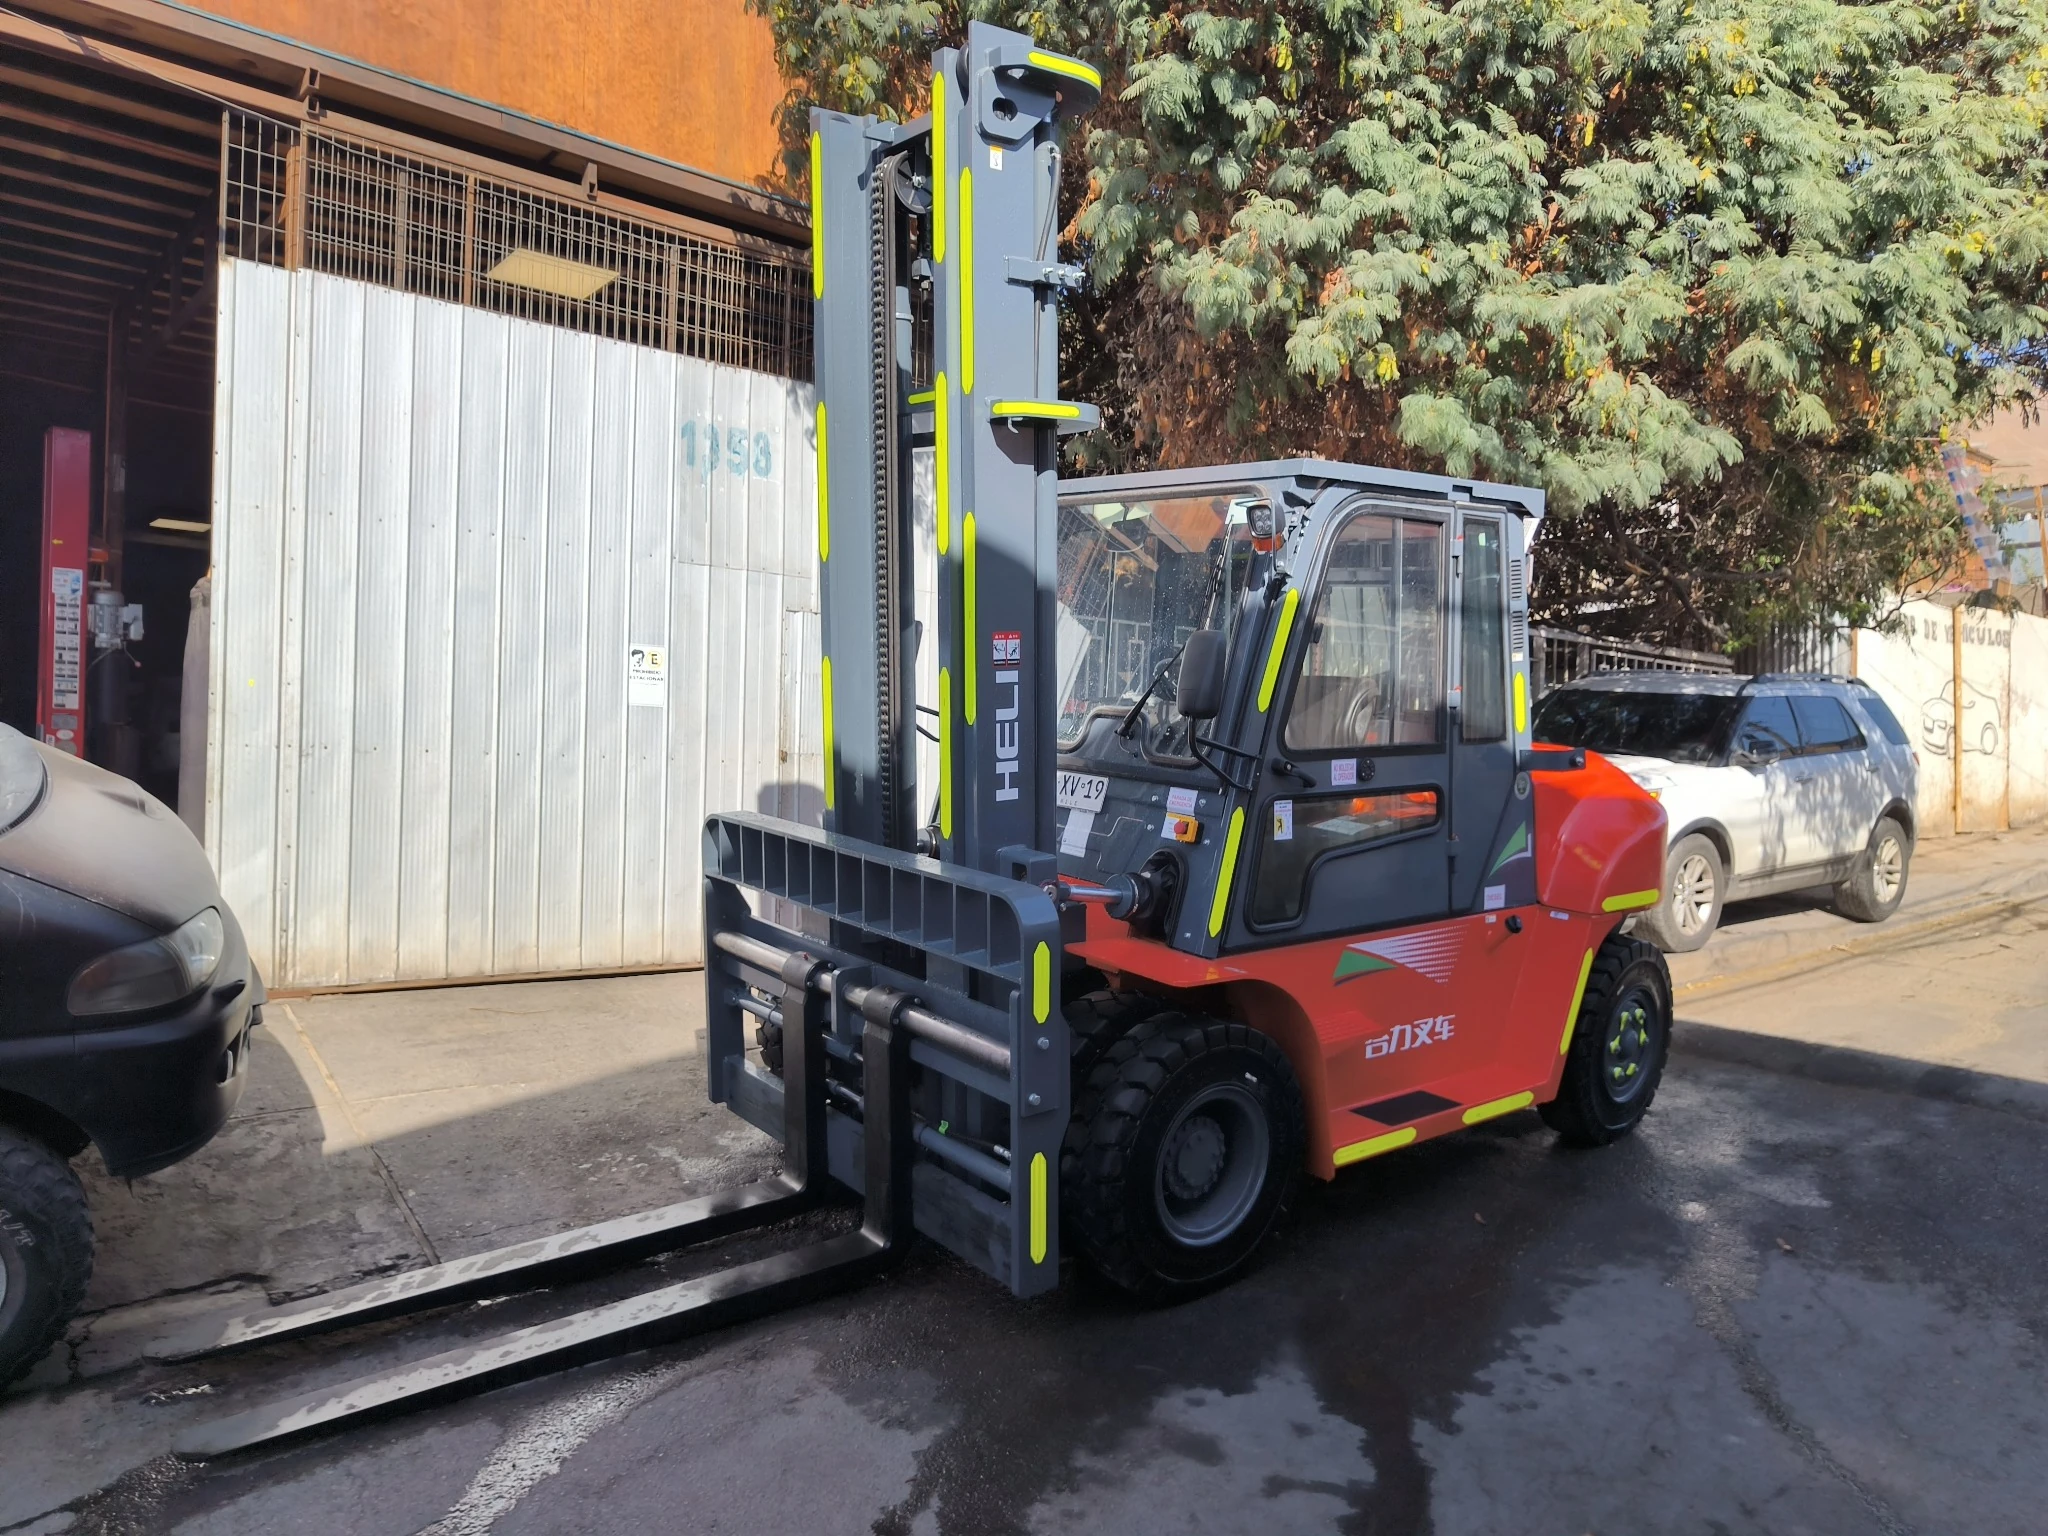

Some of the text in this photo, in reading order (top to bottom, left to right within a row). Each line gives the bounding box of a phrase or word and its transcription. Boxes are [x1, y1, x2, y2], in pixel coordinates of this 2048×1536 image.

[1924, 618, 1937, 642] DE
[651, 653, 658, 665] E
[996, 670, 1019, 802] HELI
[1365, 1014, 1456, 1059] 合力叉车
